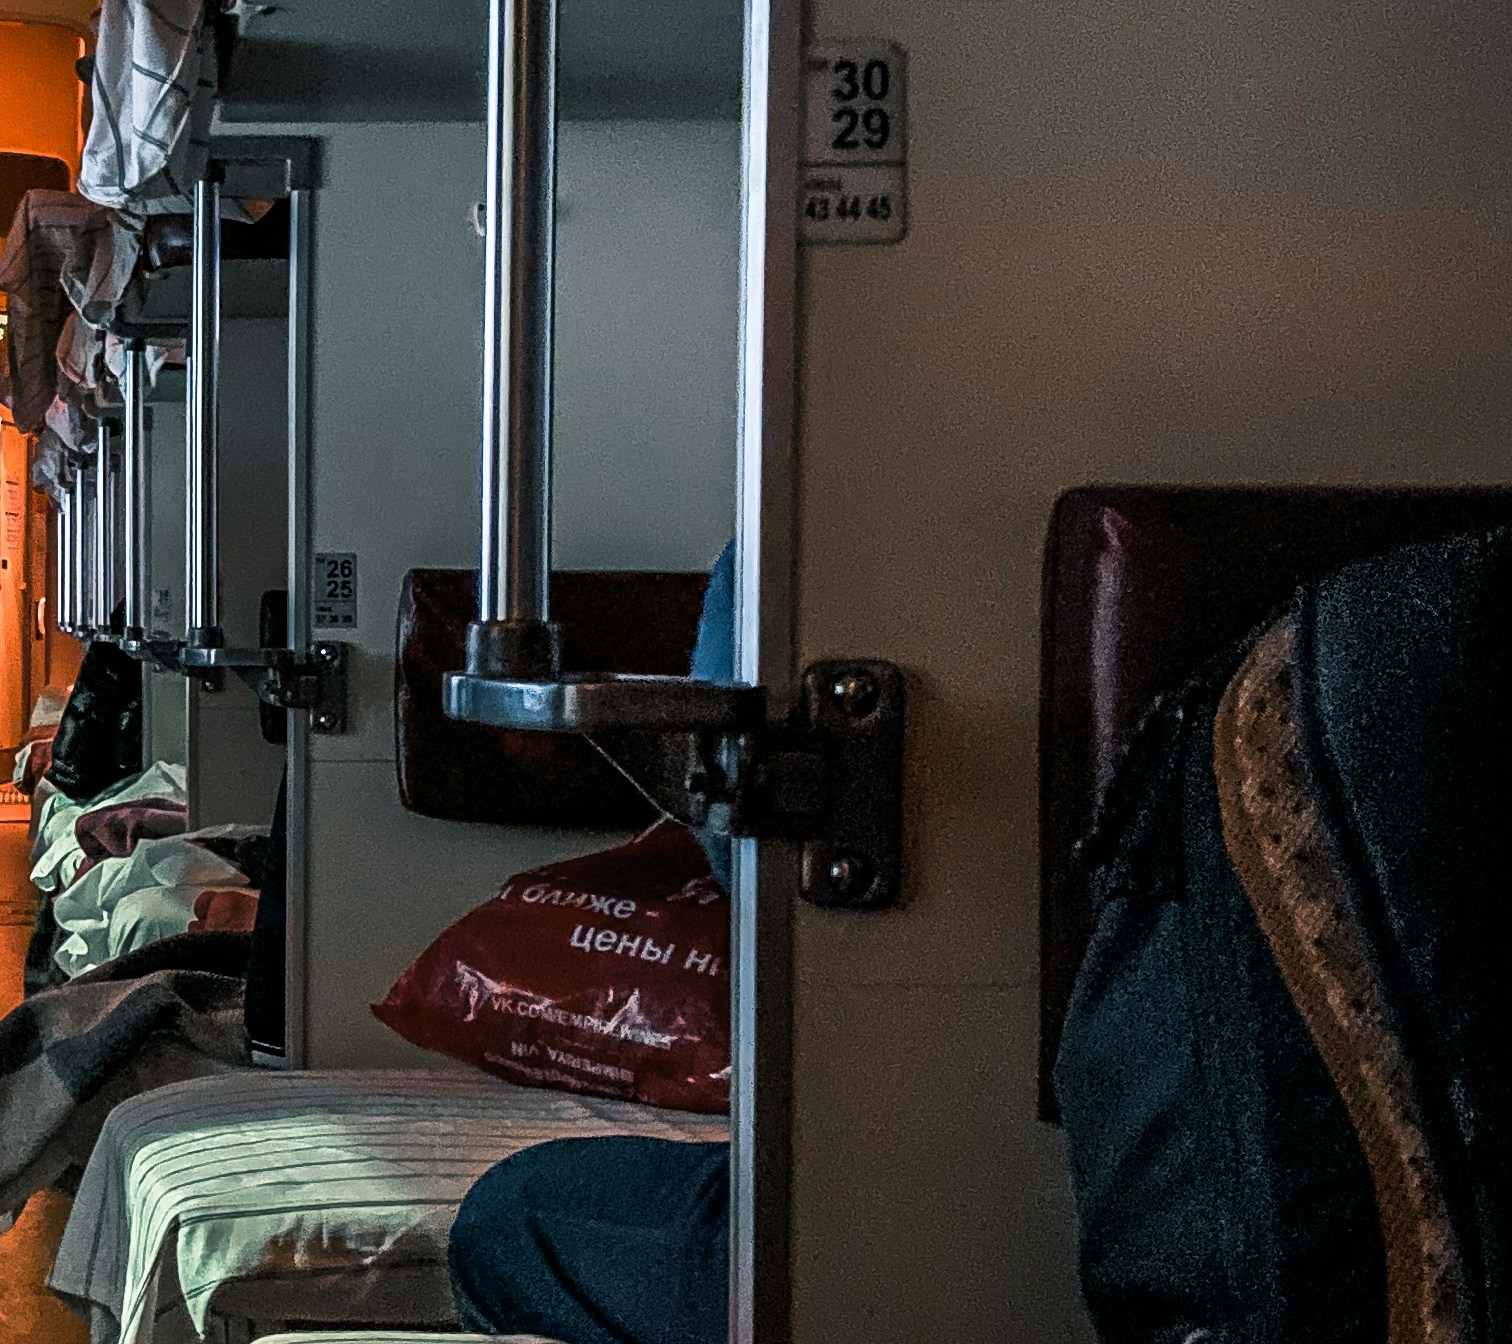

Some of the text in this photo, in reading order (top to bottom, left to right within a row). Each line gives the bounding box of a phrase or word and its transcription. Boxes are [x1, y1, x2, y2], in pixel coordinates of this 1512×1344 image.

[832, 59, 889, 102] 30
[831, 108, 890, 150] 29
[805, 195, 892, 221] 43 44 45
[327, 559, 353, 578] 26
[326, 580, 353, 599] 25
[521, 882, 637, 919] ближе
[570, 923, 677, 965] цены
